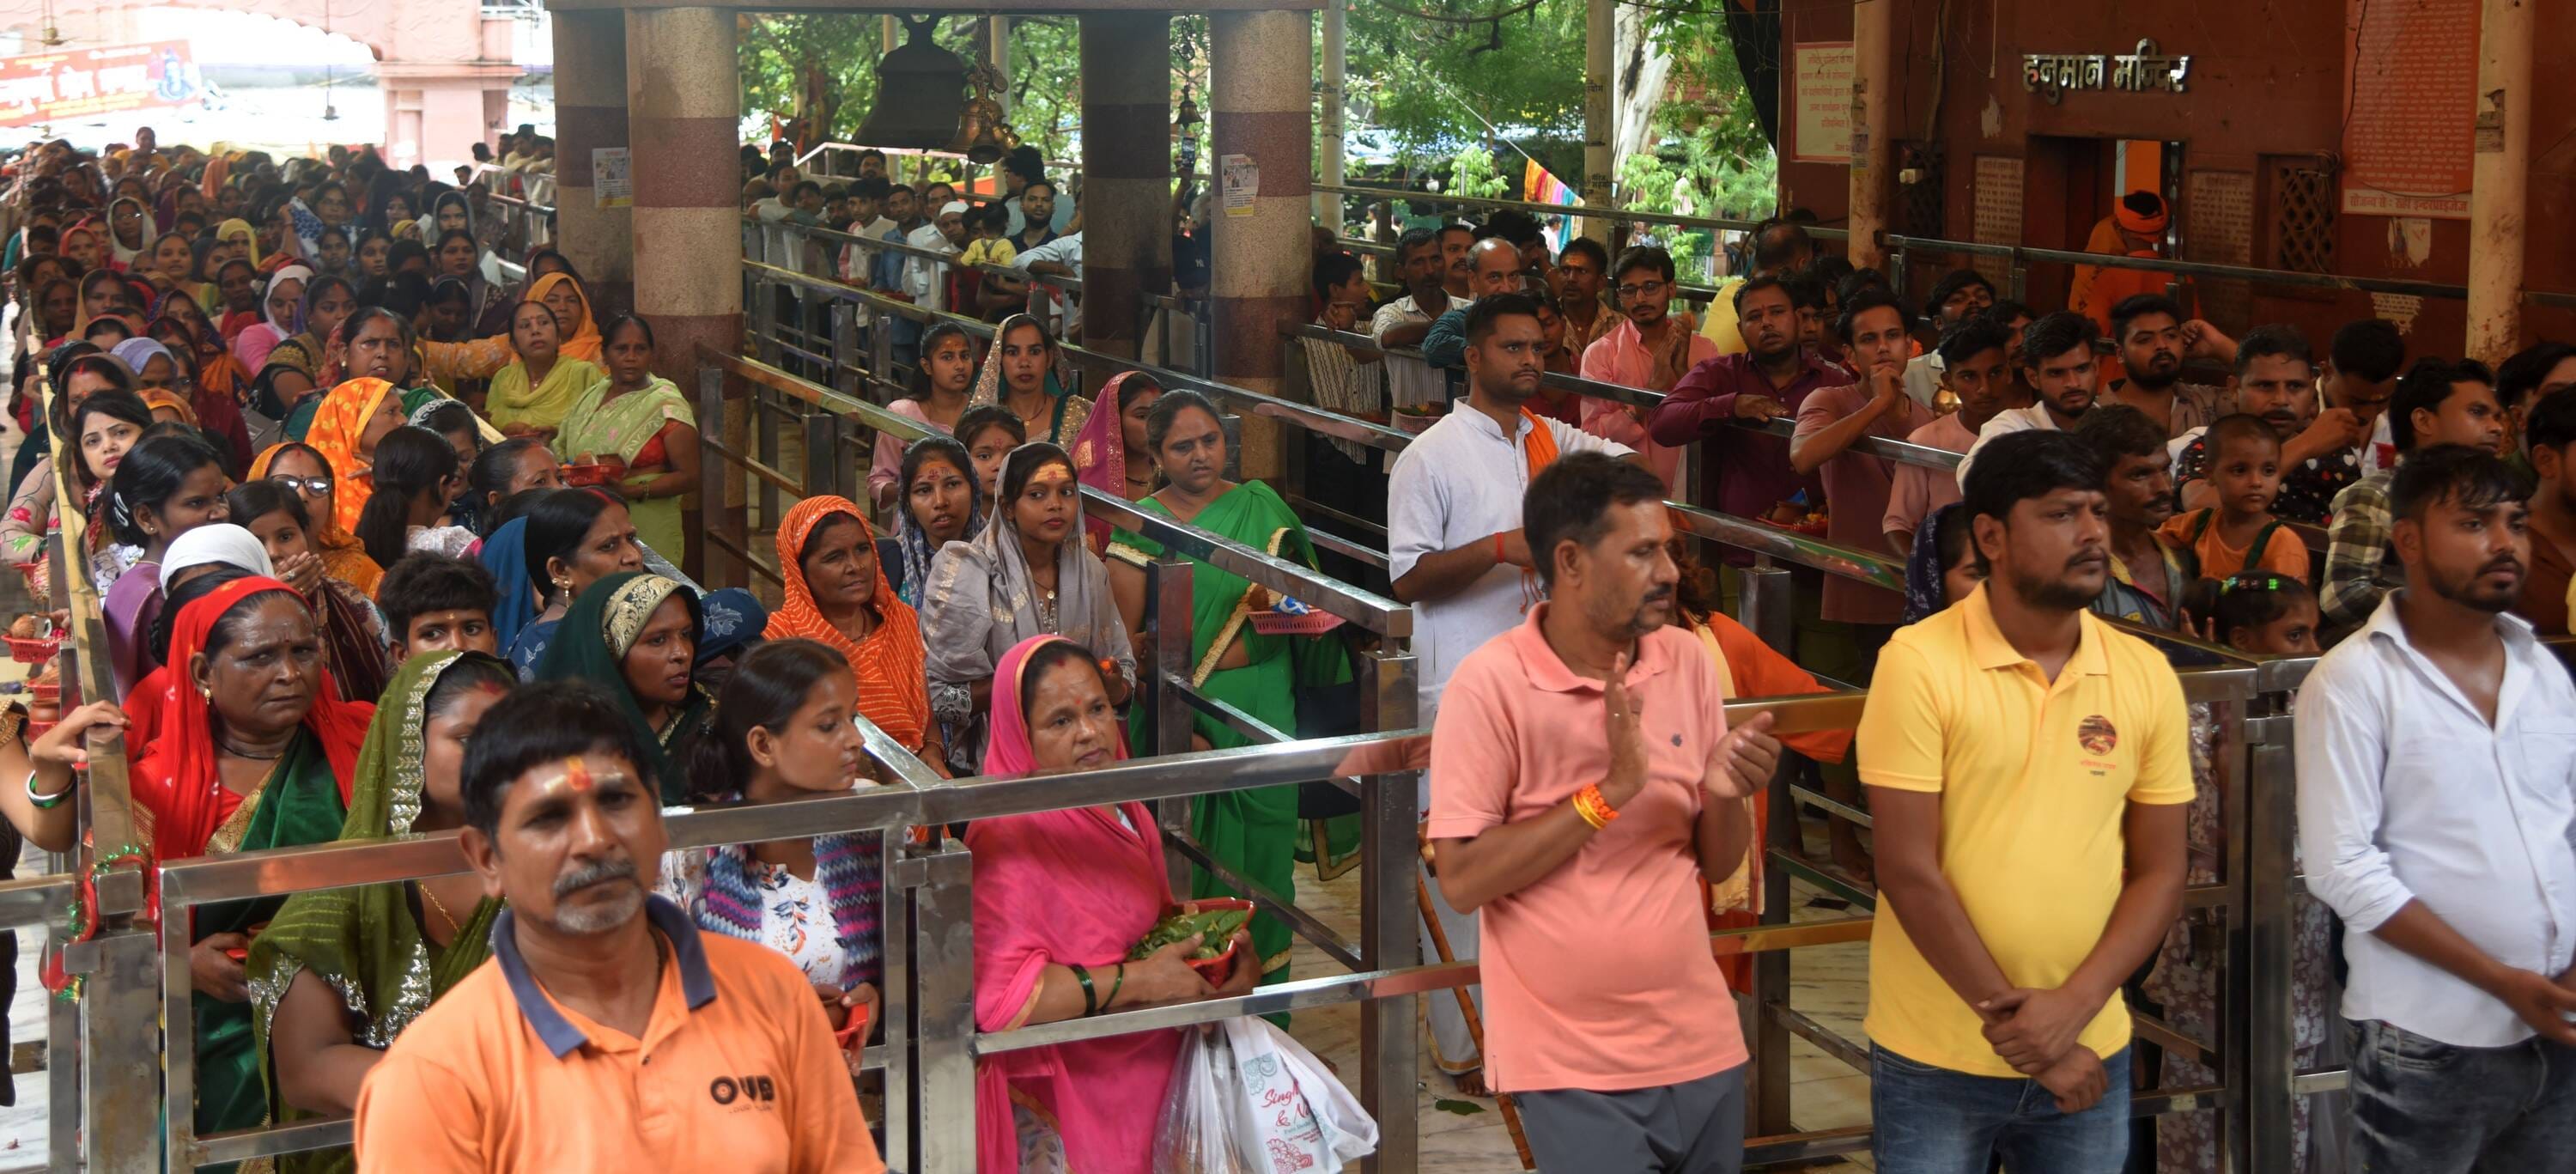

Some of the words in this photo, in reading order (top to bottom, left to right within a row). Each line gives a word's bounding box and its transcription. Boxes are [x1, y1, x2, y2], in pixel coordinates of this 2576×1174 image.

[2023, 54, 2105, 105] हनुमान
[2114, 38, 2190, 92] मन्दिर
[1276, 1109, 1291, 1127] &
